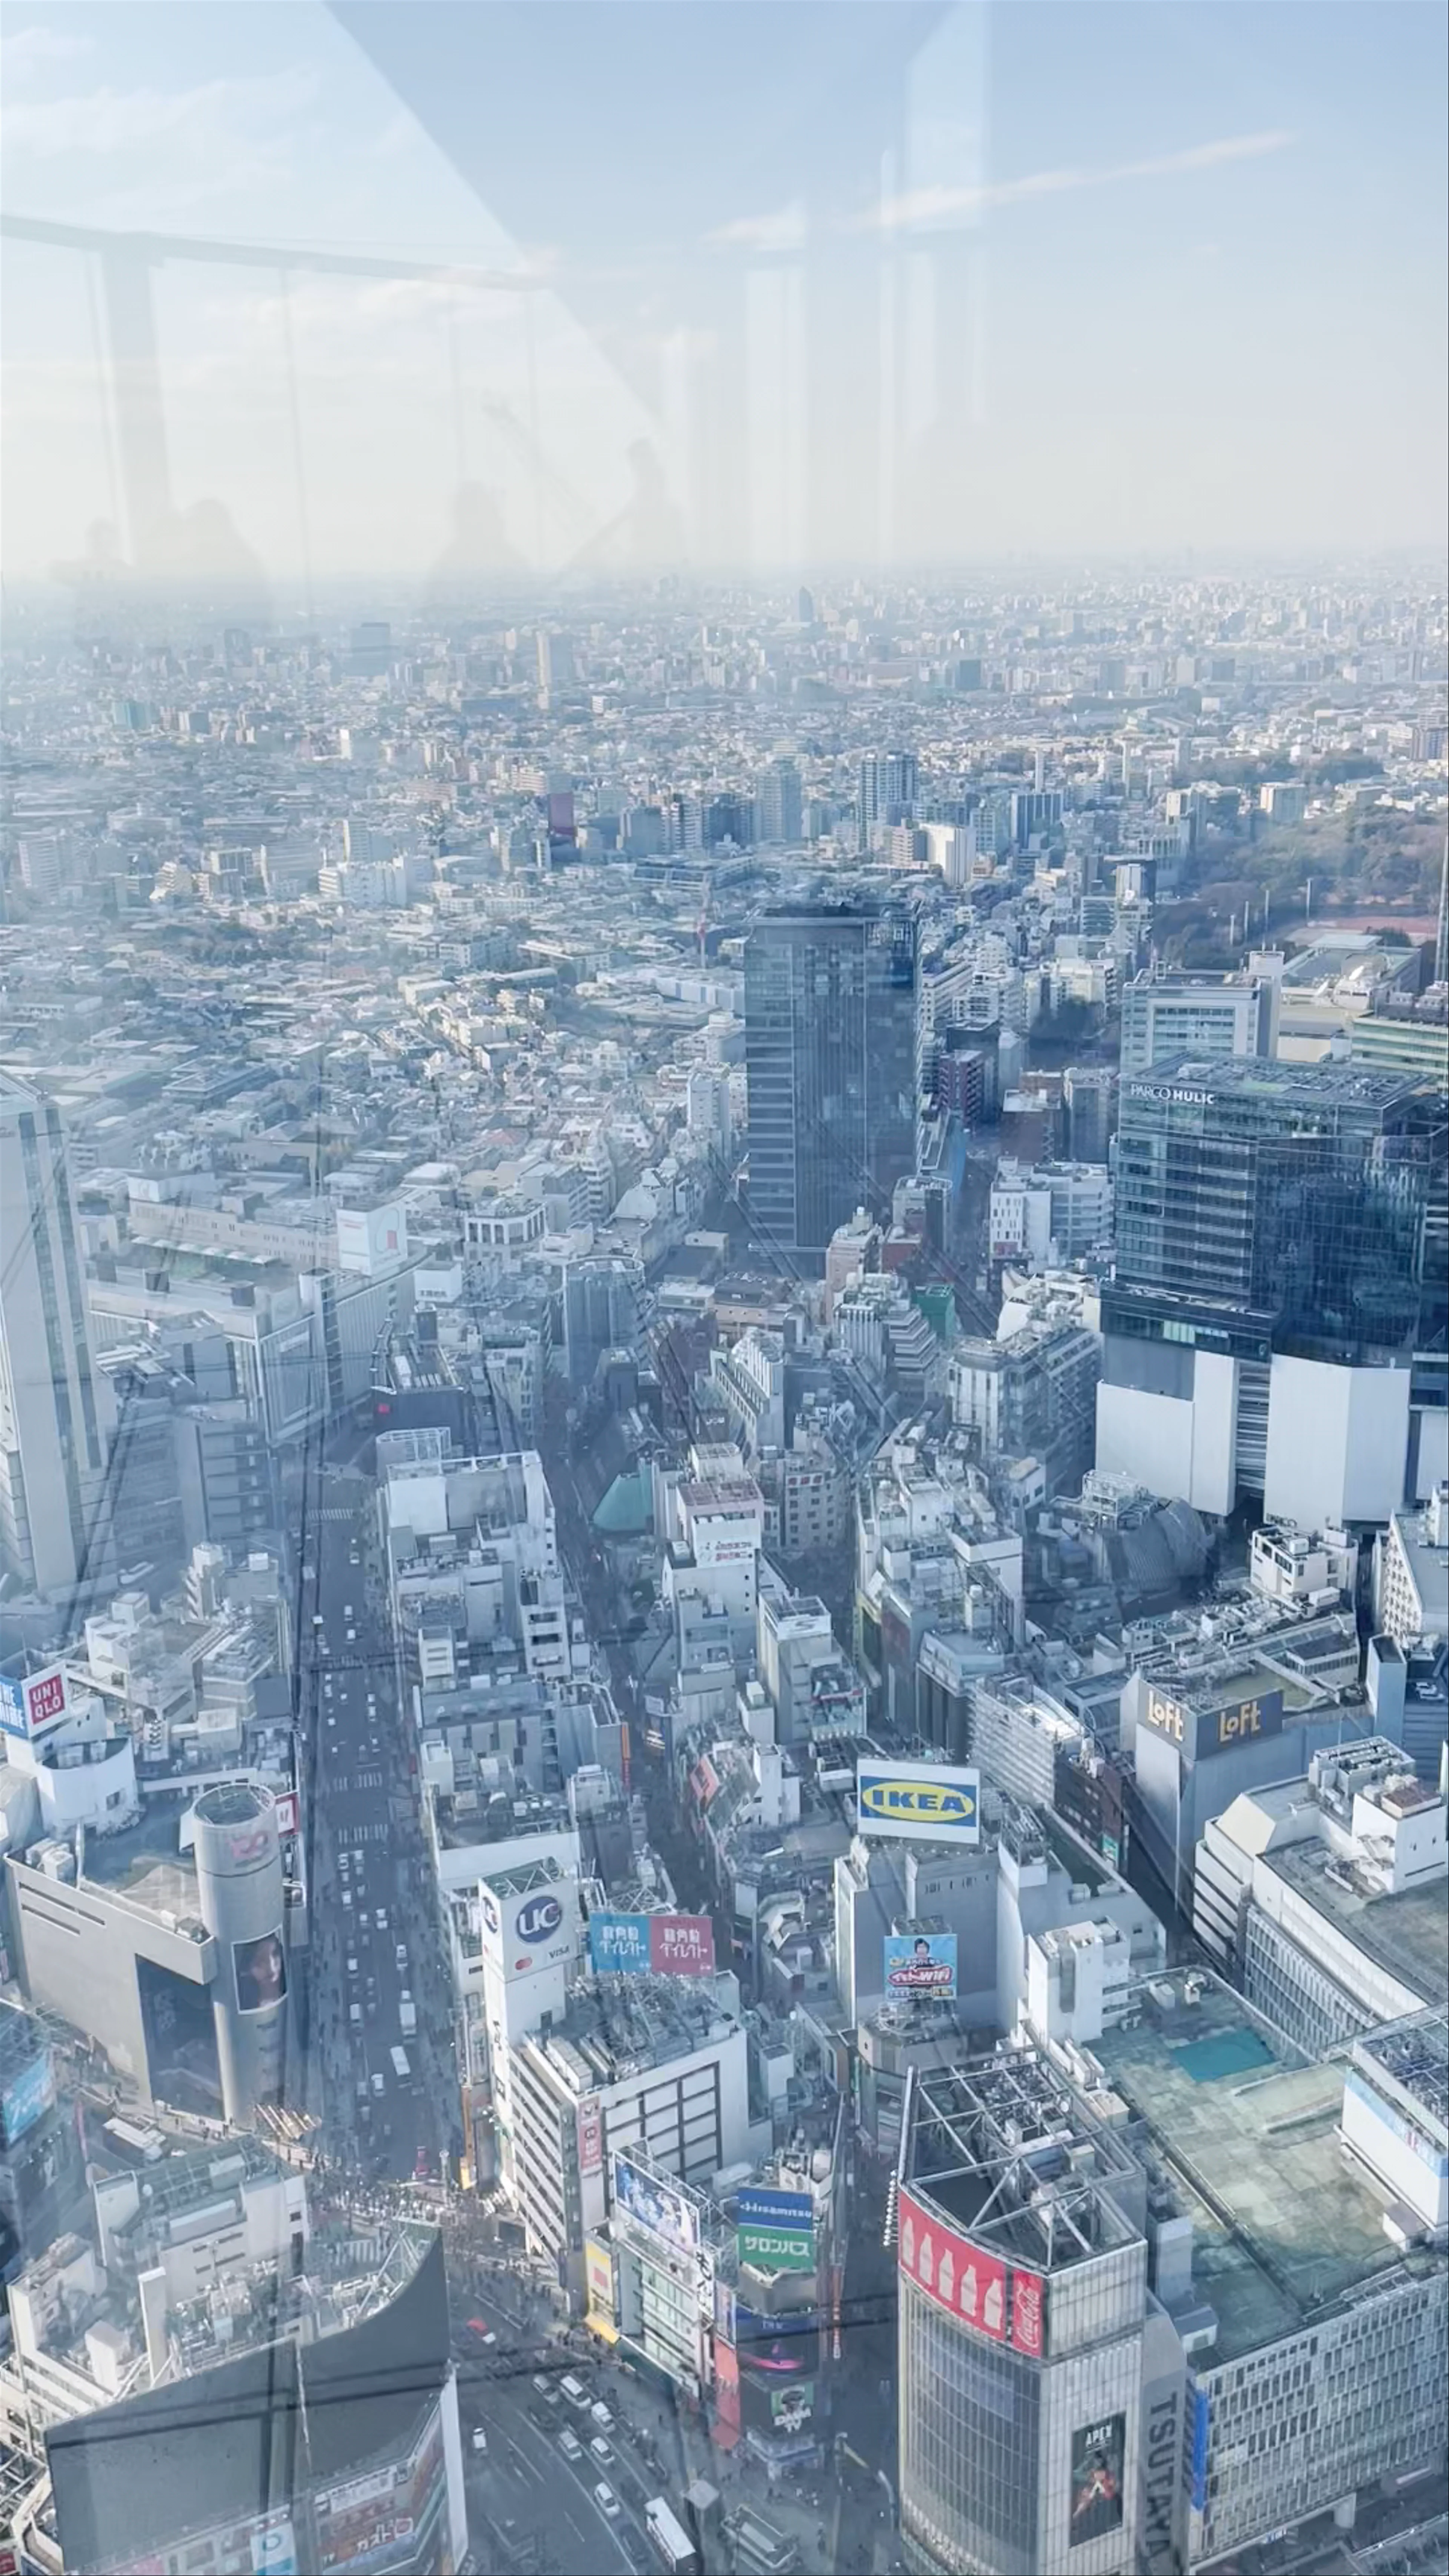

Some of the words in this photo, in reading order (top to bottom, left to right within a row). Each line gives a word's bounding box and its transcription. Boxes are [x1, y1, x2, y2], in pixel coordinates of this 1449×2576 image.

[1131, 1083, 1171, 1100] PARCO
[1173, 1089, 1215, 1104] HULIC
[32, 1680, 57, 1703] UNI
[35, 1695, 61, 1717] QLO
[872, 1789, 966, 1813] IKEA
[519, 1903, 560, 1935] UC
[549, 1945, 569, 1958] VISA
[1146, 2391, 1177, 2559] TSUTAYA
